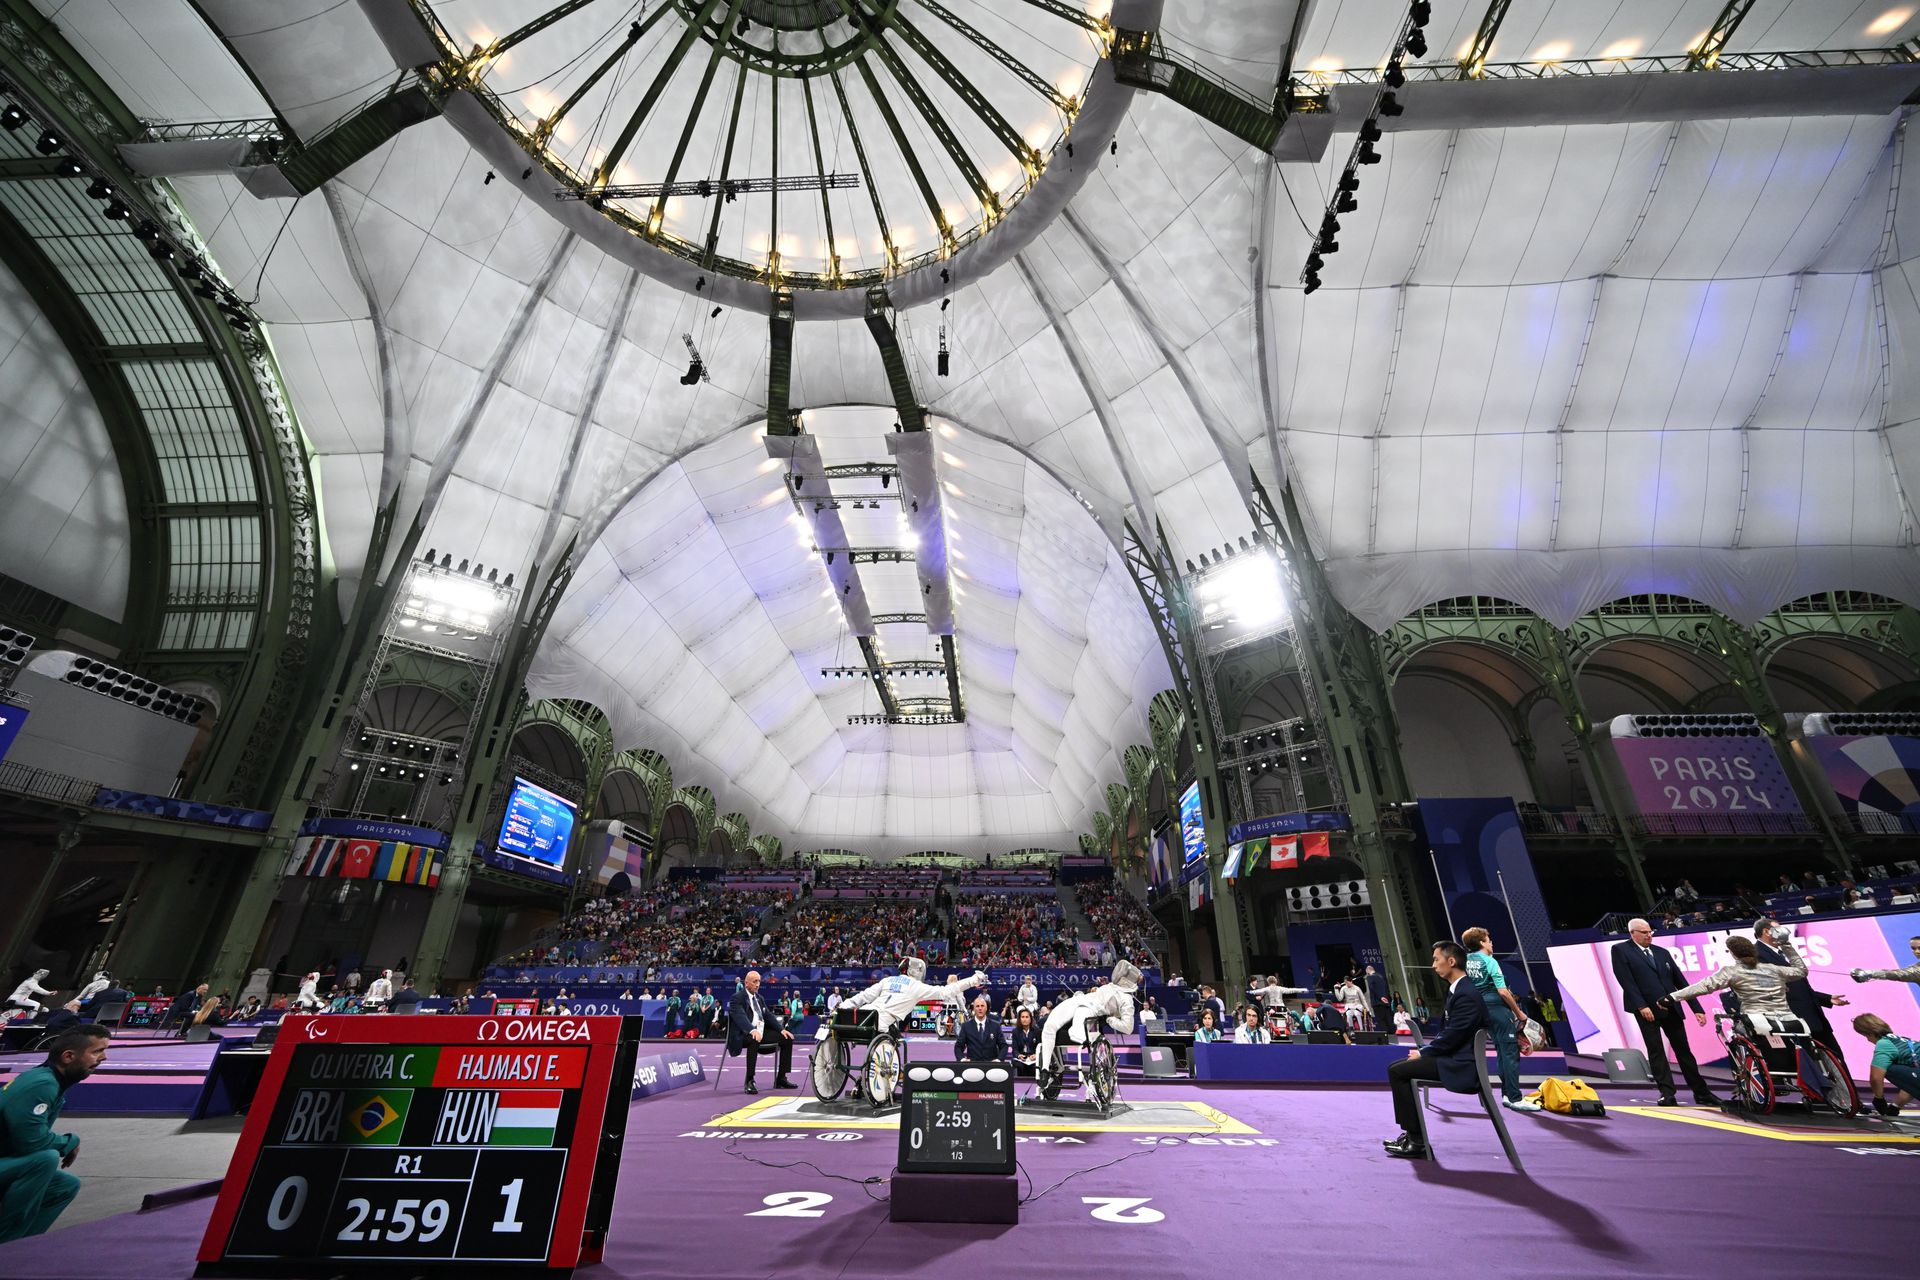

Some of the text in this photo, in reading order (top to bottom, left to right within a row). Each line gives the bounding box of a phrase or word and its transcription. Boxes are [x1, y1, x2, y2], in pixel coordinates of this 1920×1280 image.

[1663, 785, 1772, 810] 2024
[1364, 956, 1381, 964] 202
[573, 1003, 620, 1016] 2024
[505, 1020, 591, 1041] OMEGA
[310, 1053, 415, 1079] OLIVEIRA C.
[456, 1054, 561, 1081] HAJMASI E.
[668, 1061, 691, 1077] Allianz
[284, 1090, 346, 1141] BRA
[436, 1092, 499, 1143] HUN
[935, 1111, 972, 1128] 2:59
[677, 1131, 809, 1140] Allianz
[910, 1127, 923, 1149] 0
[992, 1128, 1002, 1150] 1
[1015, 1136, 1086, 1144] OTA
[394, 1155, 422, 1174] R1
[951, 1152, 963, 1160] 1/3
[266, 1175, 309, 1231] 0
[492, 1178, 524, 1232] 1
[744, 1191, 833, 1218] 2
[336, 1198, 450, 1242] 2:59
